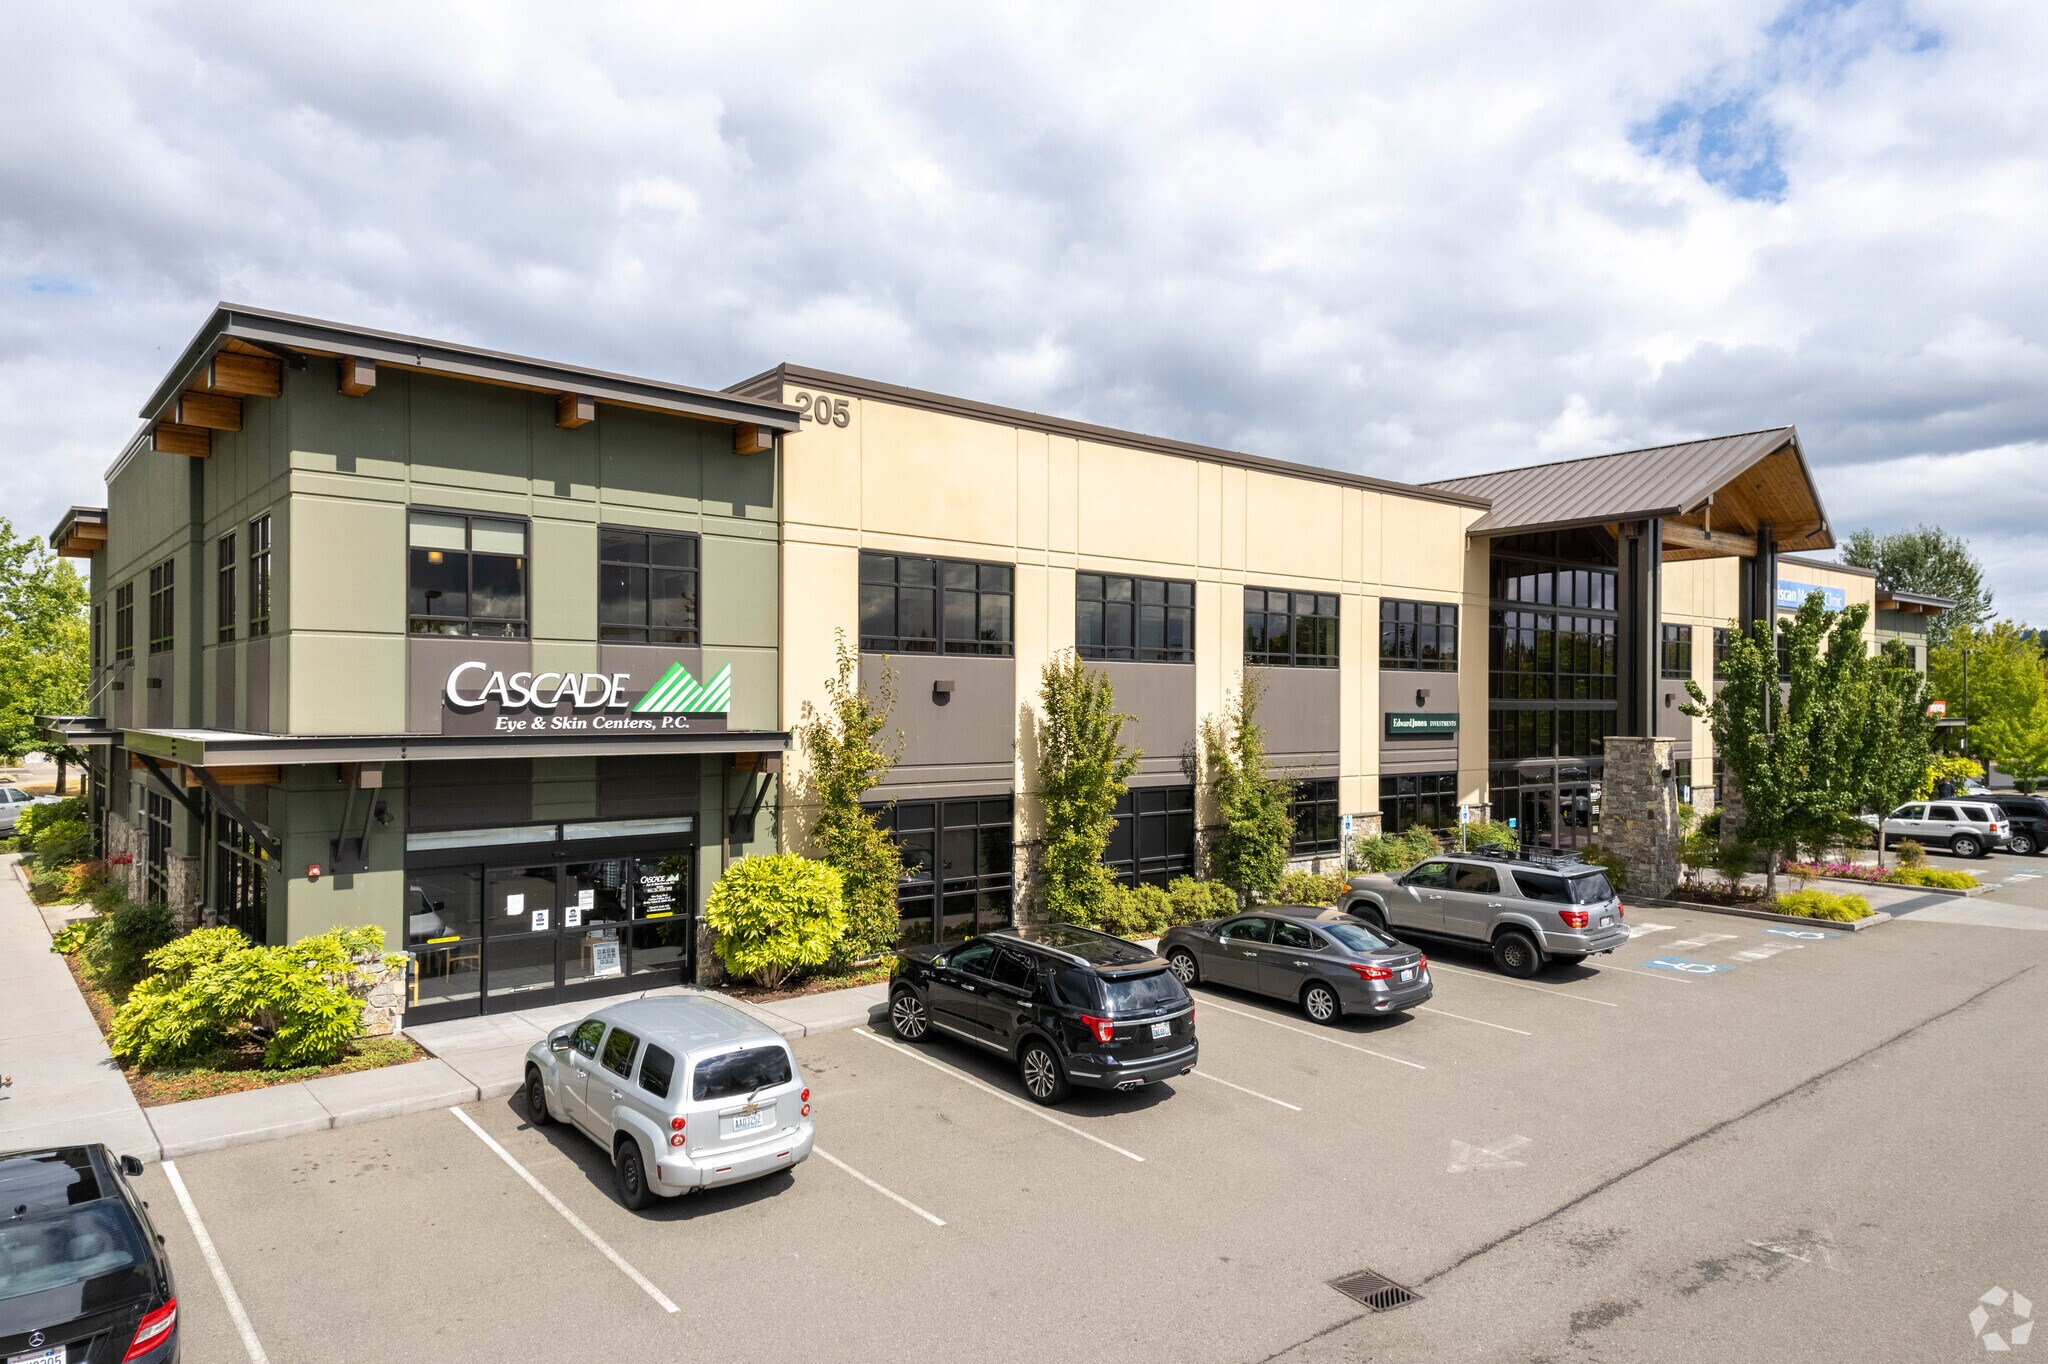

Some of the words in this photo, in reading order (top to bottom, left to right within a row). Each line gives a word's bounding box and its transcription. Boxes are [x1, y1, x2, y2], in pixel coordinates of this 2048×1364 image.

[795, 391, 850, 428] 205
[1825, 592, 1843, 608] Clinic
[446, 661, 631, 709] CASCADE
[495, 716, 527, 731] Eye
[531, 716, 547, 730] &
[551, 716, 588, 730] Skin
[592, 716, 657, 731] Centers,
[661, 716, 690, 729] P.C.
[640, 875, 665, 884] CASCADE
